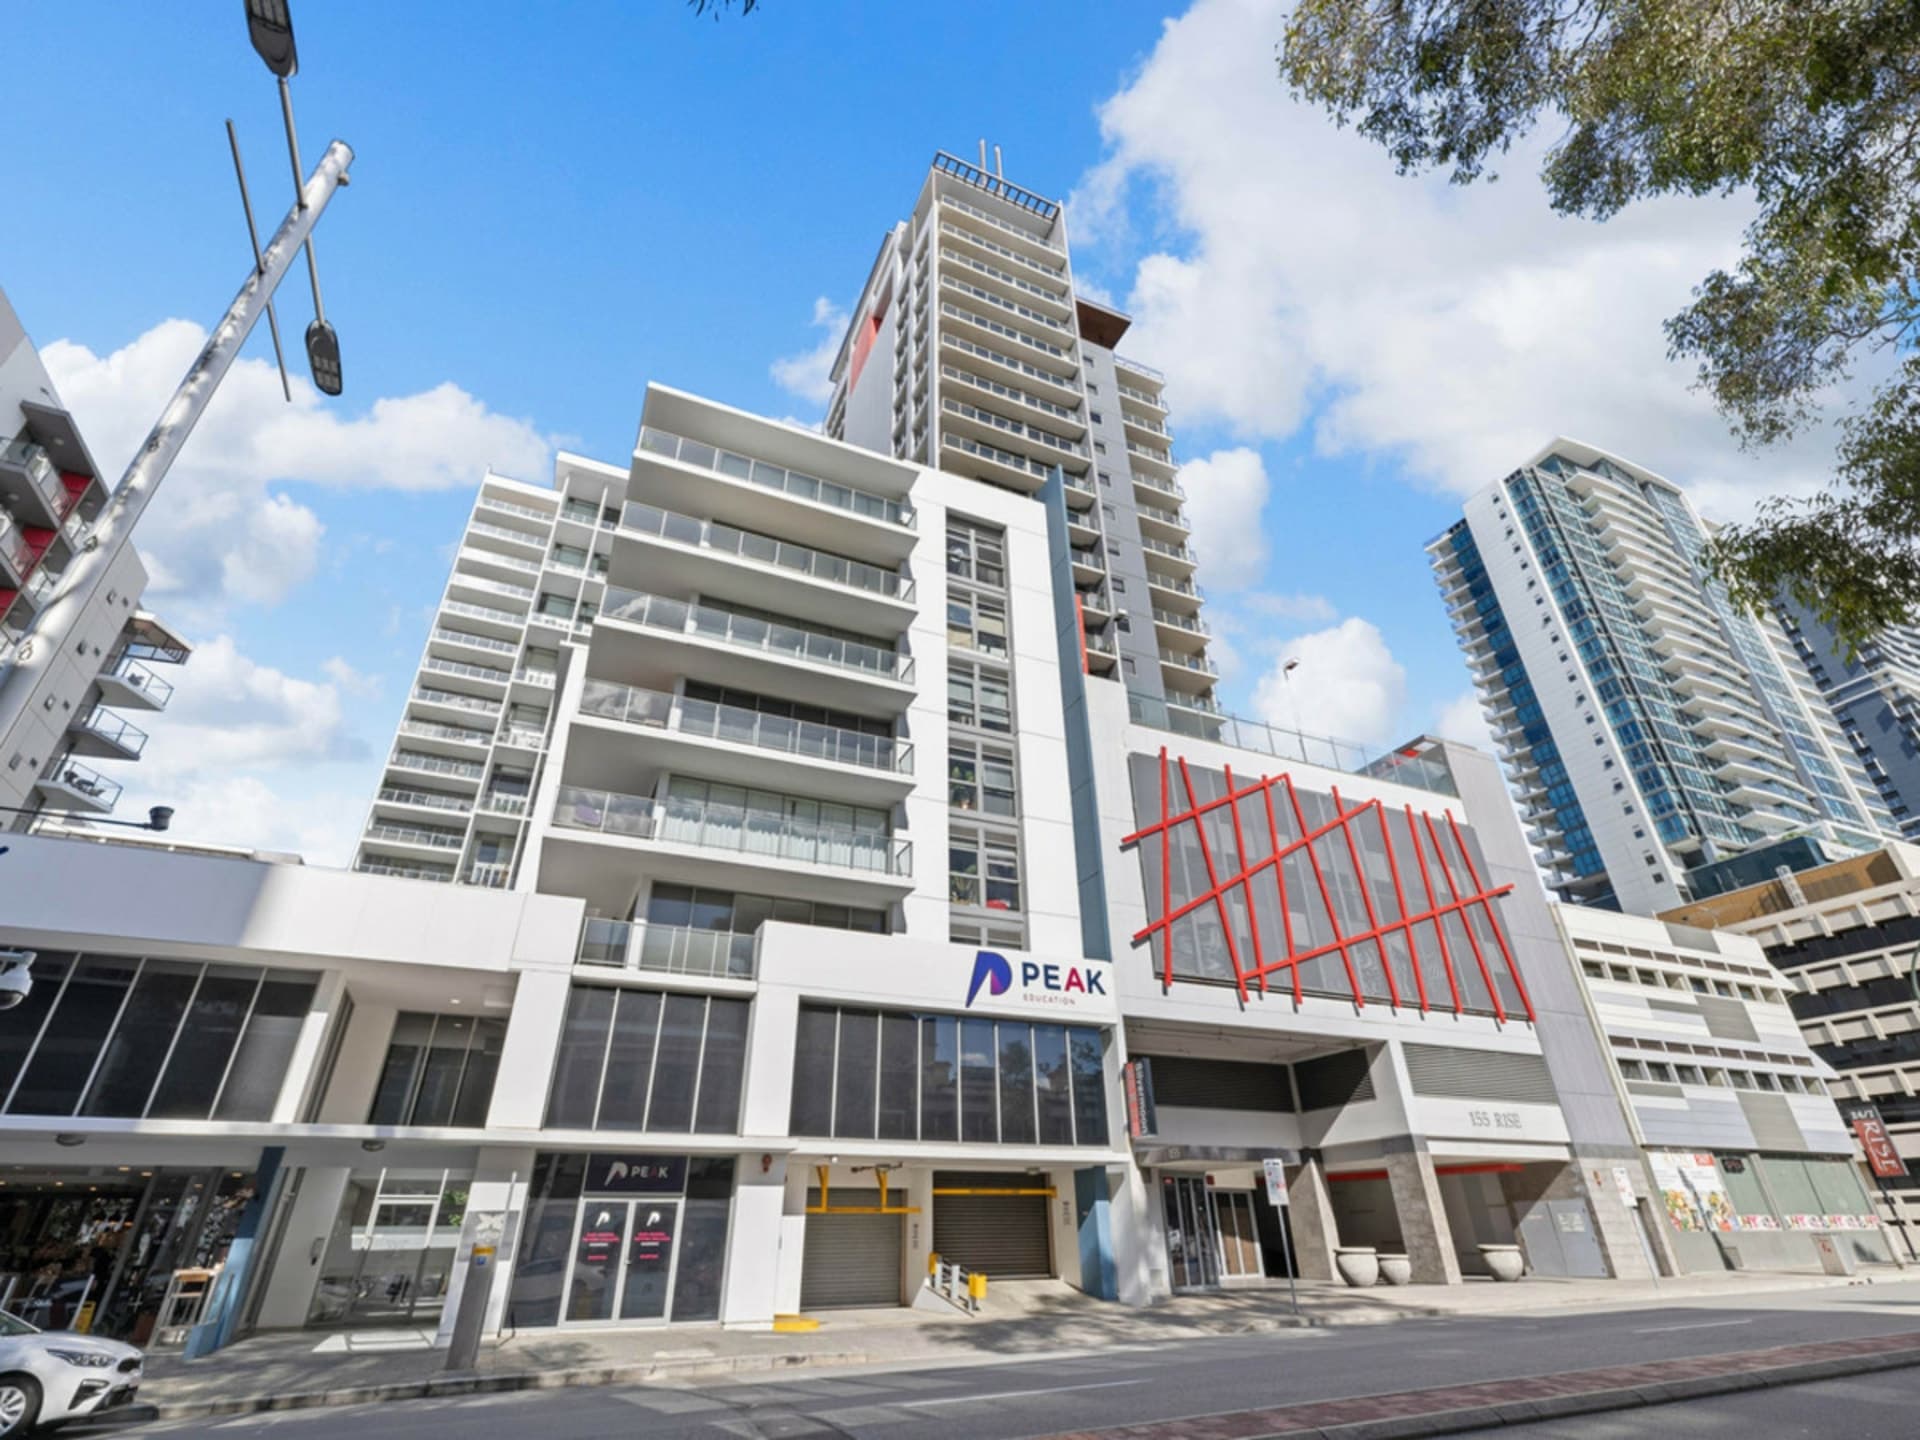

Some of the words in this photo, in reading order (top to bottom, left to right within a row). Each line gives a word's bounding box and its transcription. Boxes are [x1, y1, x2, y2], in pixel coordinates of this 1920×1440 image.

[1021, 961, 1107, 996] PEAK
[1023, 993, 1076, 1006] EDUCATION
[630, 1165, 669, 1179] PEAK
